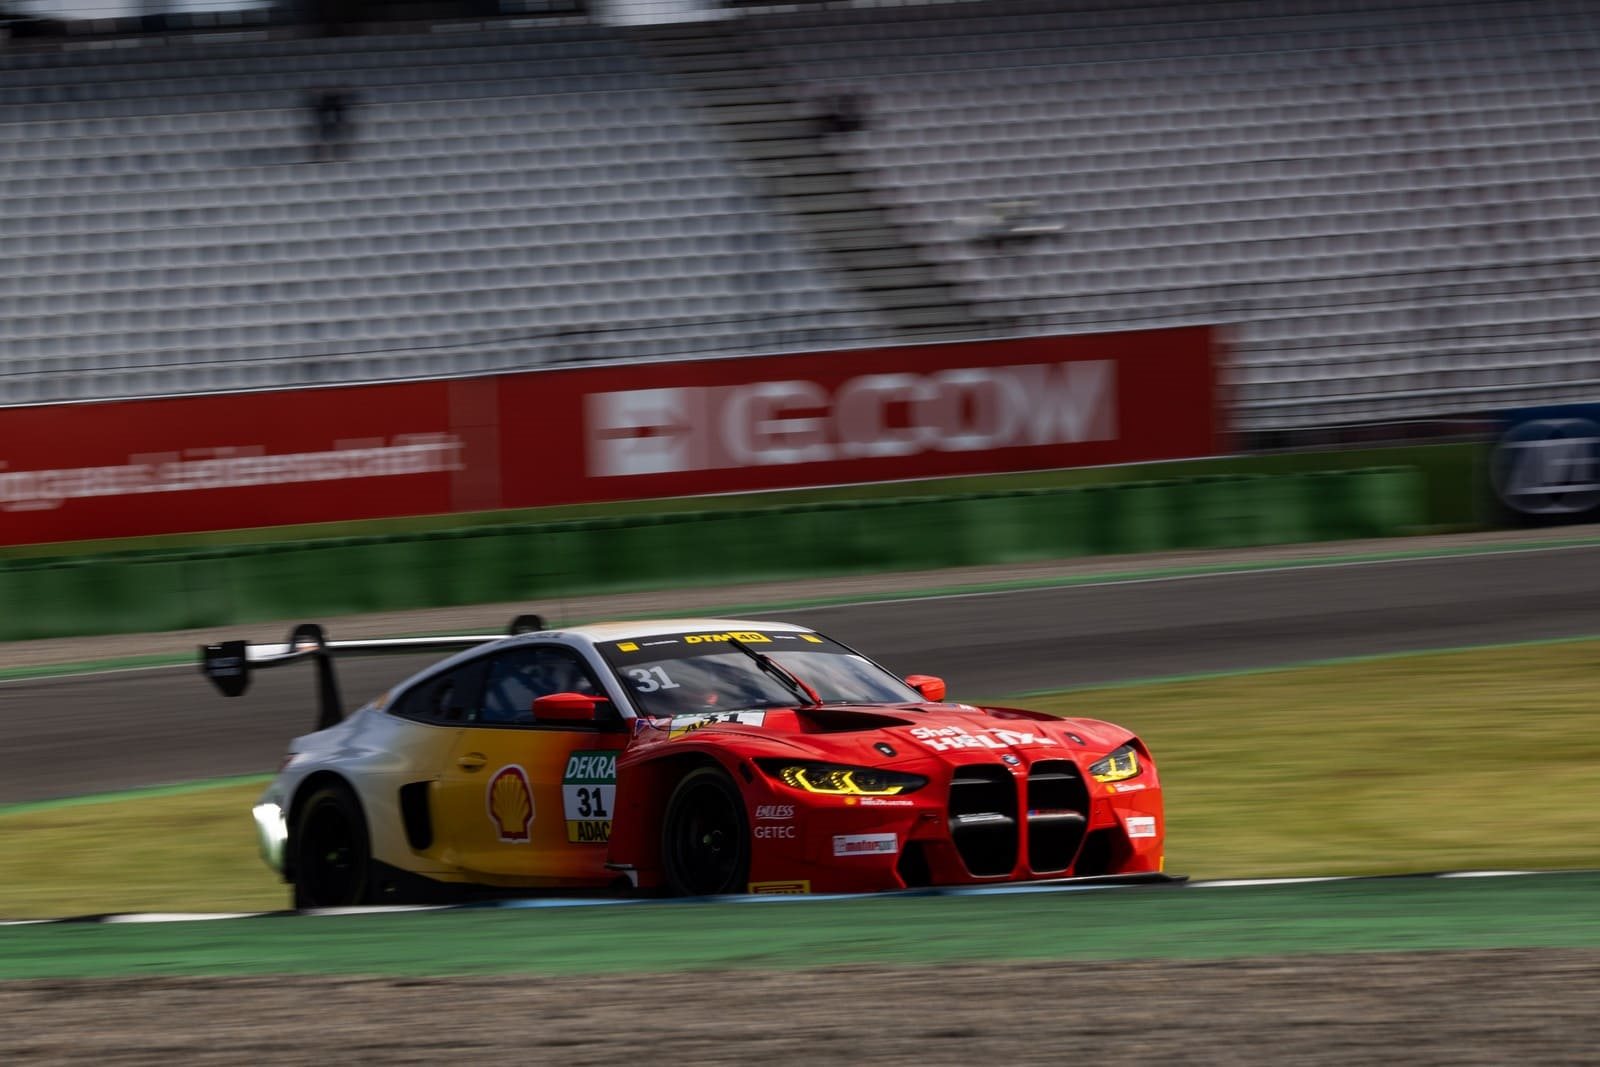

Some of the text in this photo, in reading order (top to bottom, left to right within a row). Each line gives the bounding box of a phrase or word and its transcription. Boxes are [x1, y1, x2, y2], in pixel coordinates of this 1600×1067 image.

[684, 633, 732, 644] DTM
[629, 665, 680, 692] 31
[910, 726, 967, 739] Shell
[565, 756, 617, 778] DEKRA
[576, 787, 607, 817] 31
[578, 821, 610, 841] ADAC
[754, 826, 796, 838] GETEC
